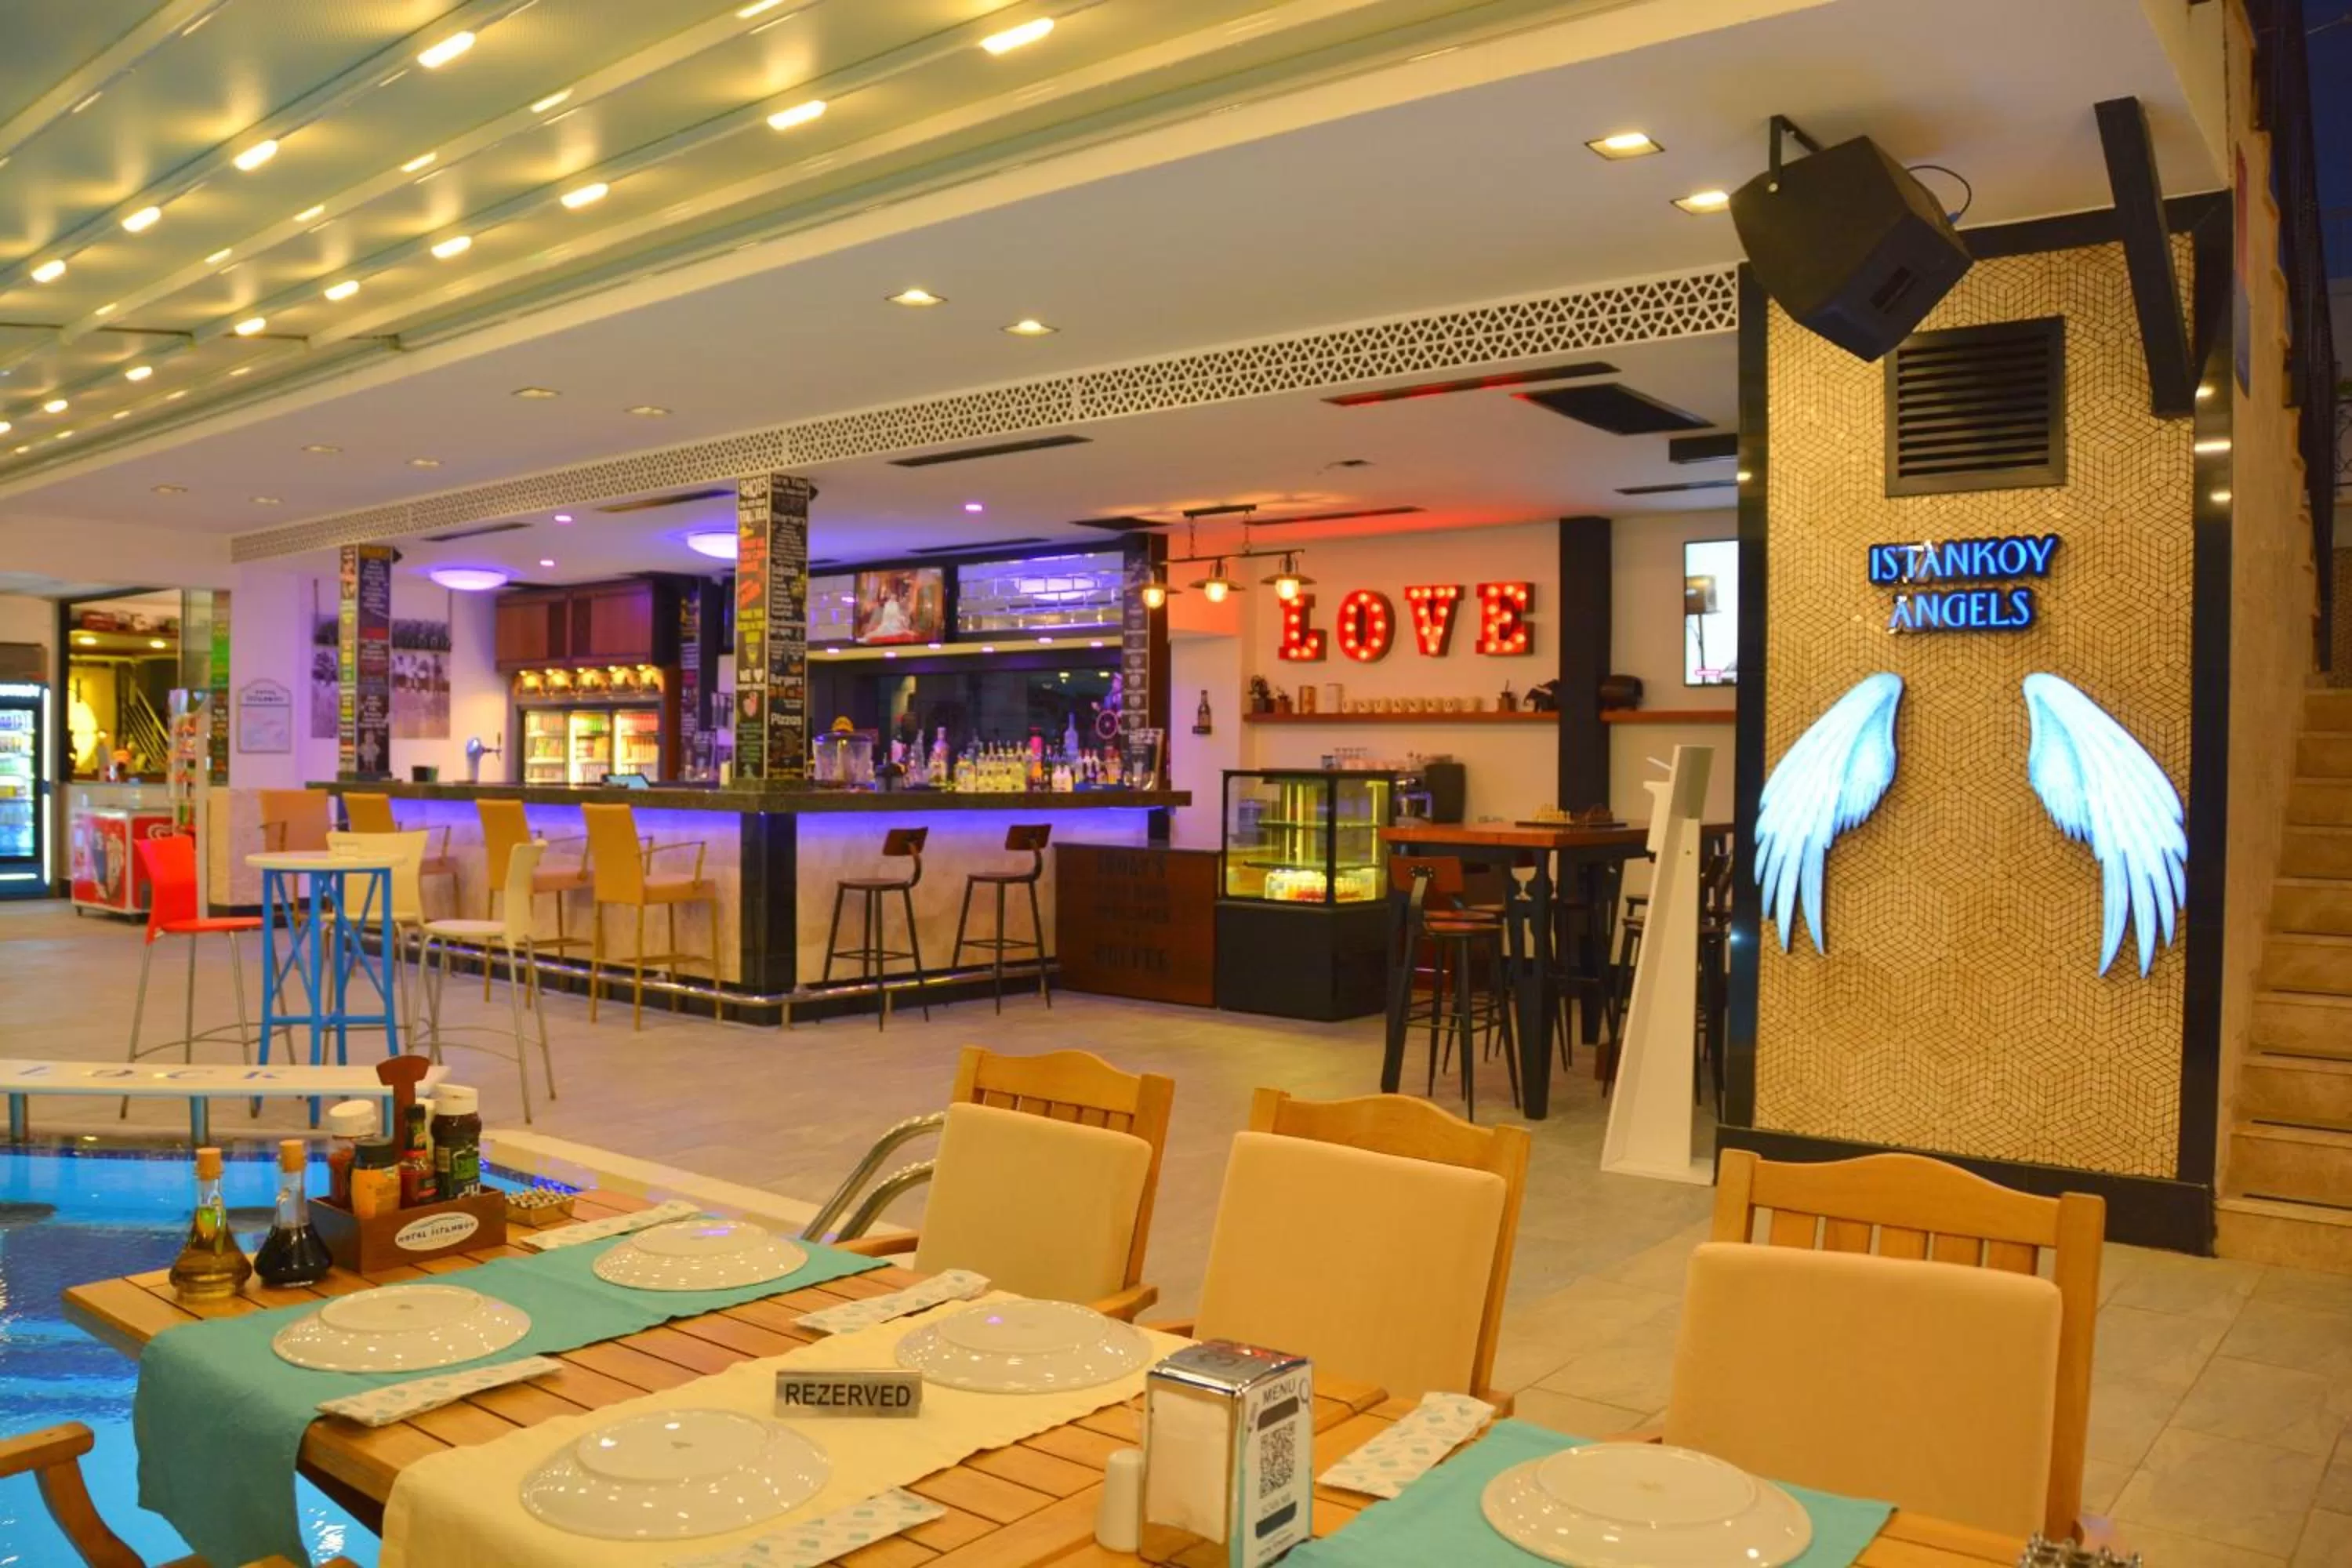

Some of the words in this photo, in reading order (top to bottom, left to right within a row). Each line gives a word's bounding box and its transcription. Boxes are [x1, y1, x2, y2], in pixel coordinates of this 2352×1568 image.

[1871, 536, 2056, 582] ISTANKOY
[1279, 582, 1535, 662] LOVE
[1888, 590, 2031, 632] ANGELS
[786, 1382, 911, 1407] REZERVED
[1262, 1377, 1296, 1403] MENU
